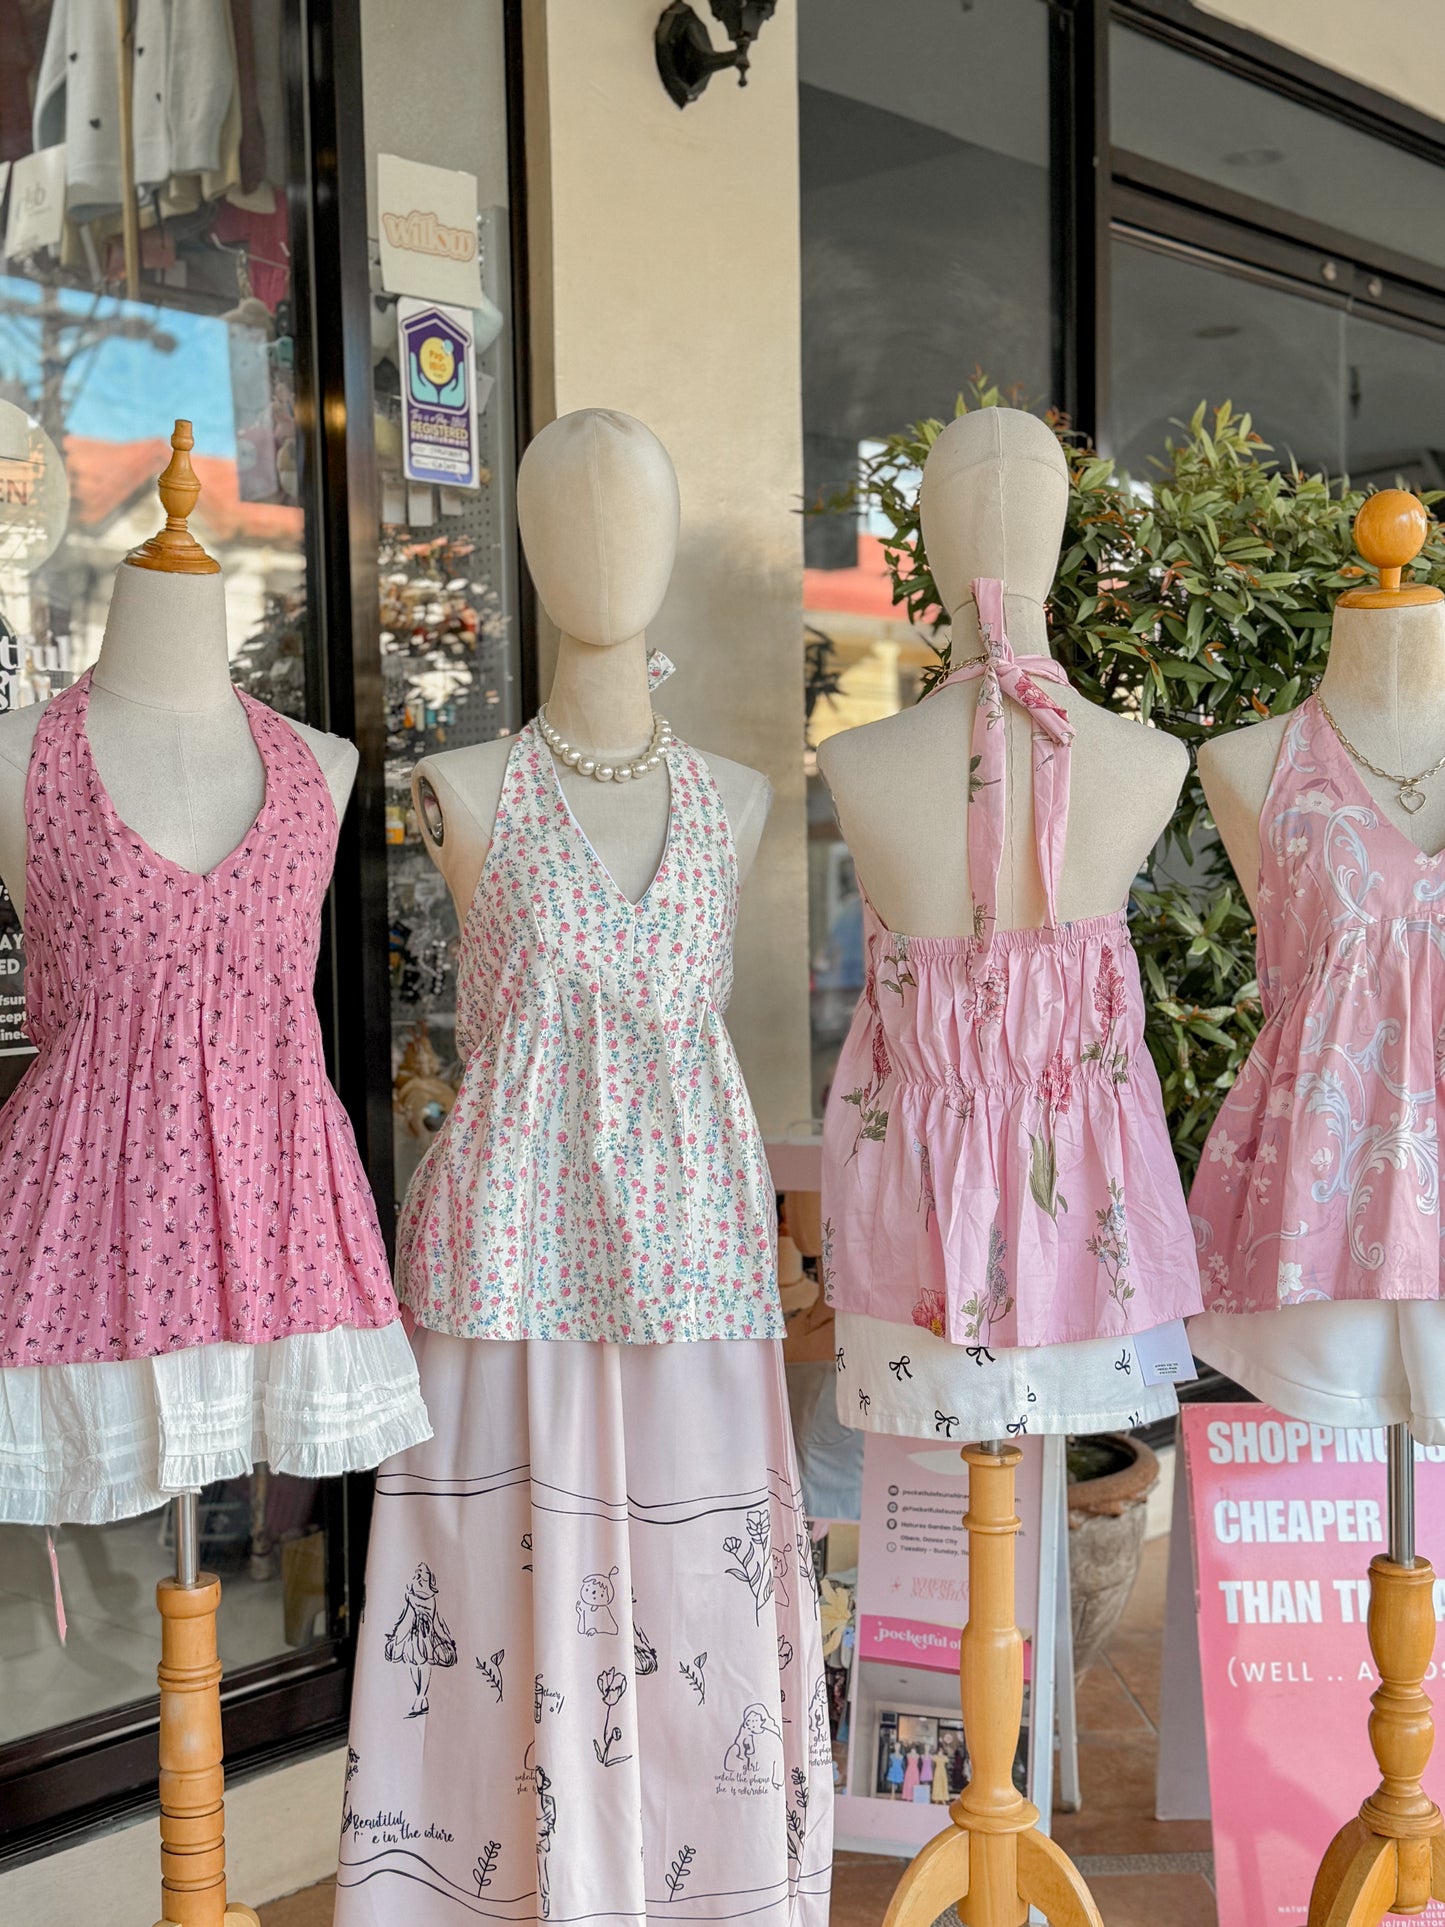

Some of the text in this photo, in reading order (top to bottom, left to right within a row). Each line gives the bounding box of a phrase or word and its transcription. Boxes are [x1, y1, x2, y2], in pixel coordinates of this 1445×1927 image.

[411, 421, 468, 440] REGISTERED
[1214, 1500, 1383, 1543] CHEAPER
[1219, 1580, 1322, 1623] THAN
[874, 1620, 947, 1650] pocketful
